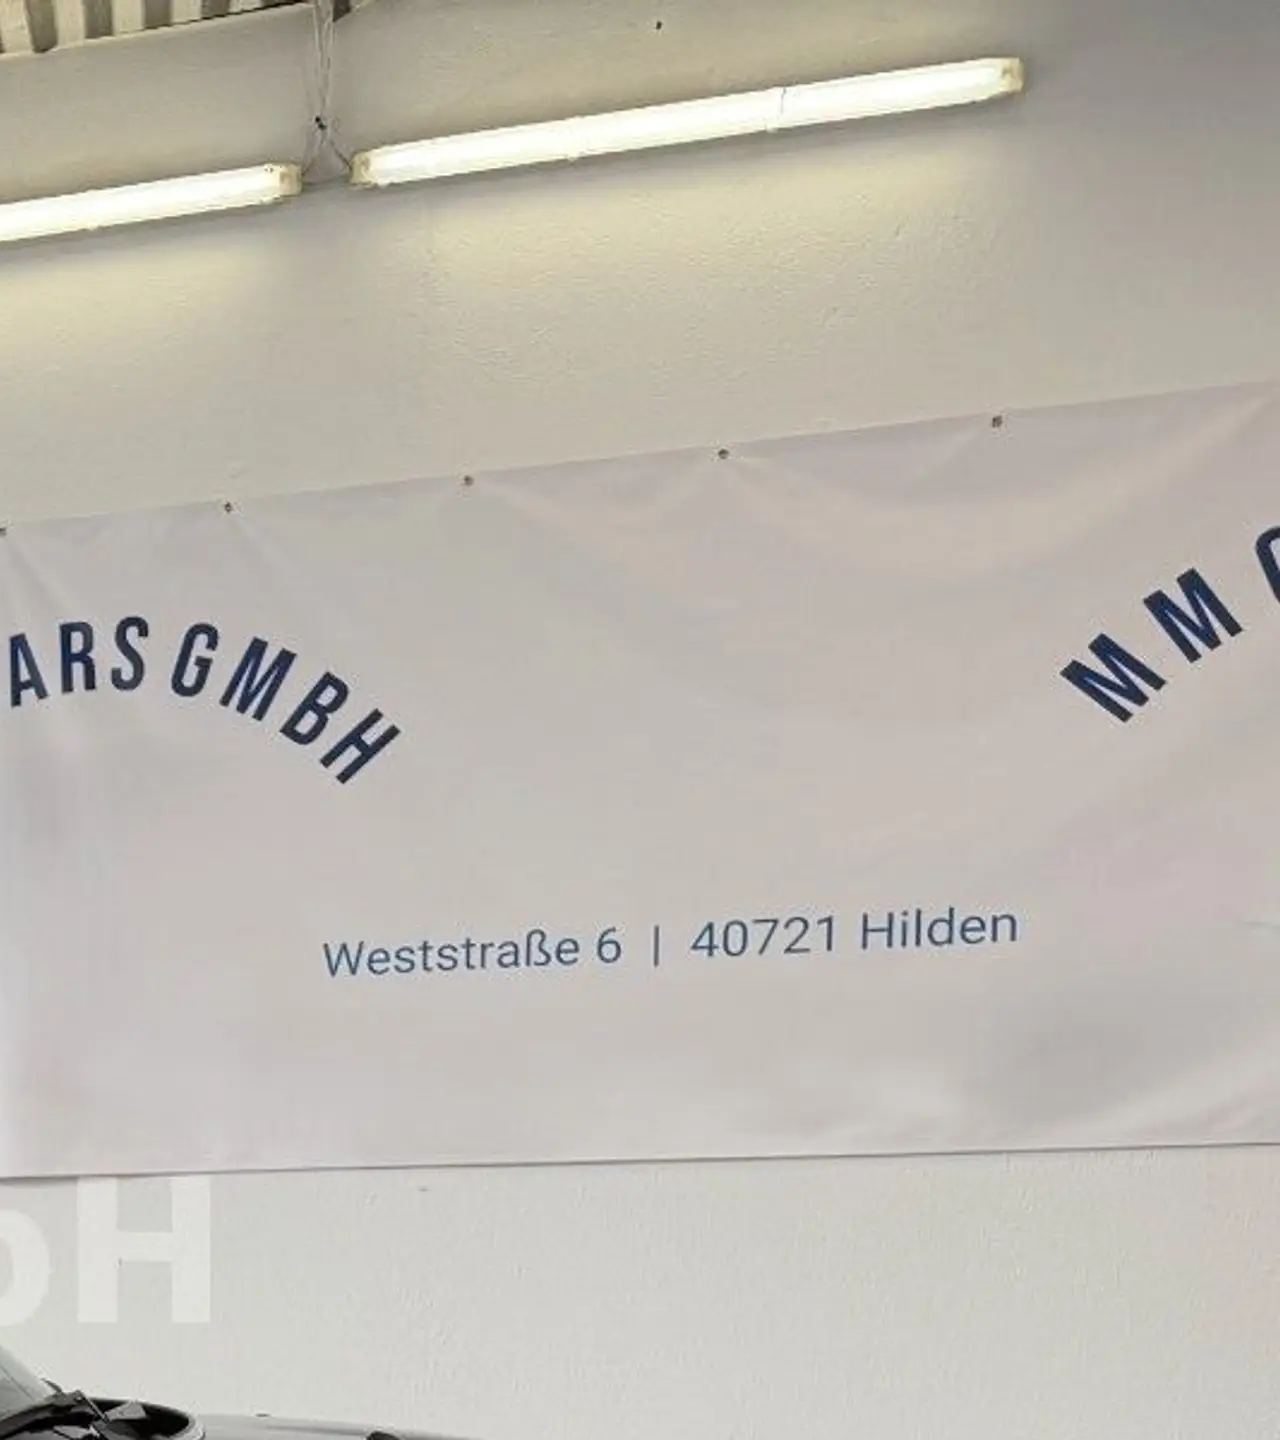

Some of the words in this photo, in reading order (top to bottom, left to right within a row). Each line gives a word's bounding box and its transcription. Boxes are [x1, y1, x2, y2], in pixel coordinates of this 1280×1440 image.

[171, 622, 401, 785] GMBH
[1059, 633, 1167, 723] M
[1143, 567, 1244, 664] M
[322, 928, 580, 978] Weststraße
[596, 926, 622, 964] 6
[690, 915, 835, 957] 40721
[861, 906, 1017, 951] Hilden
